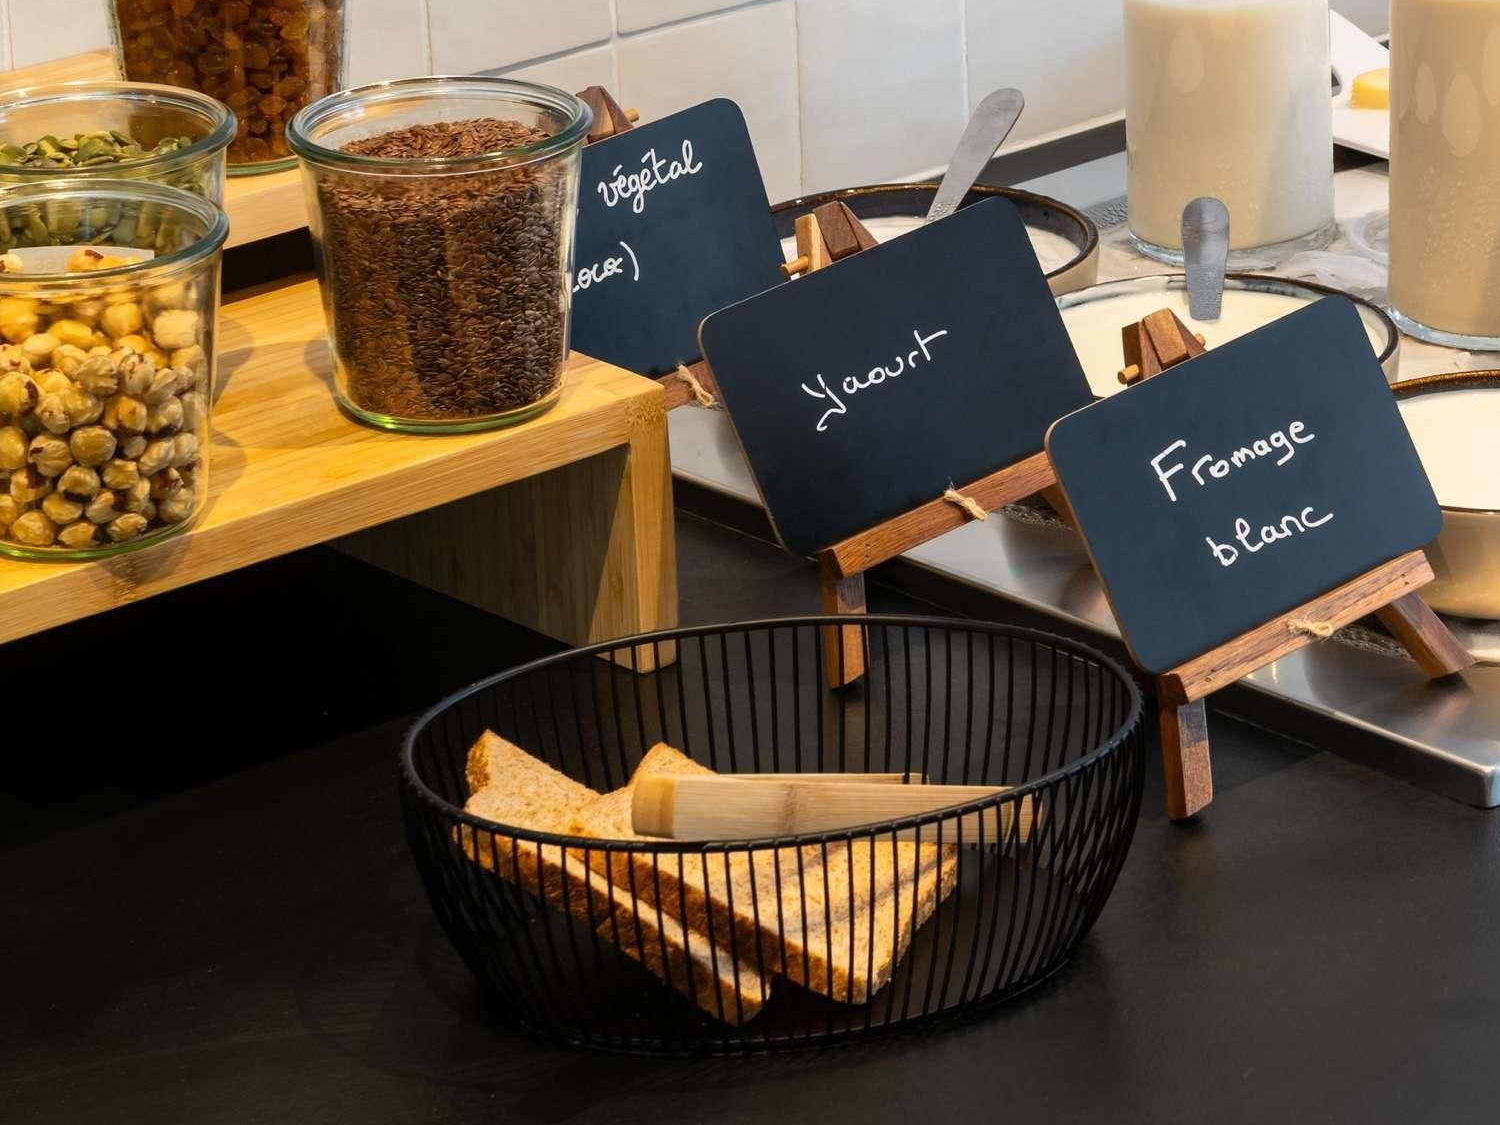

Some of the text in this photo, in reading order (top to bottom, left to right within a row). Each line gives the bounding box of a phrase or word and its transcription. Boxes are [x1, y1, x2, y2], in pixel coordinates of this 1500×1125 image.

[597, 139, 703, 214] végétal
[801, 329, 948, 432] Yaourt
[1150, 420, 1316, 502] Fromage
[1205, 505, 1334, 567] blanc
